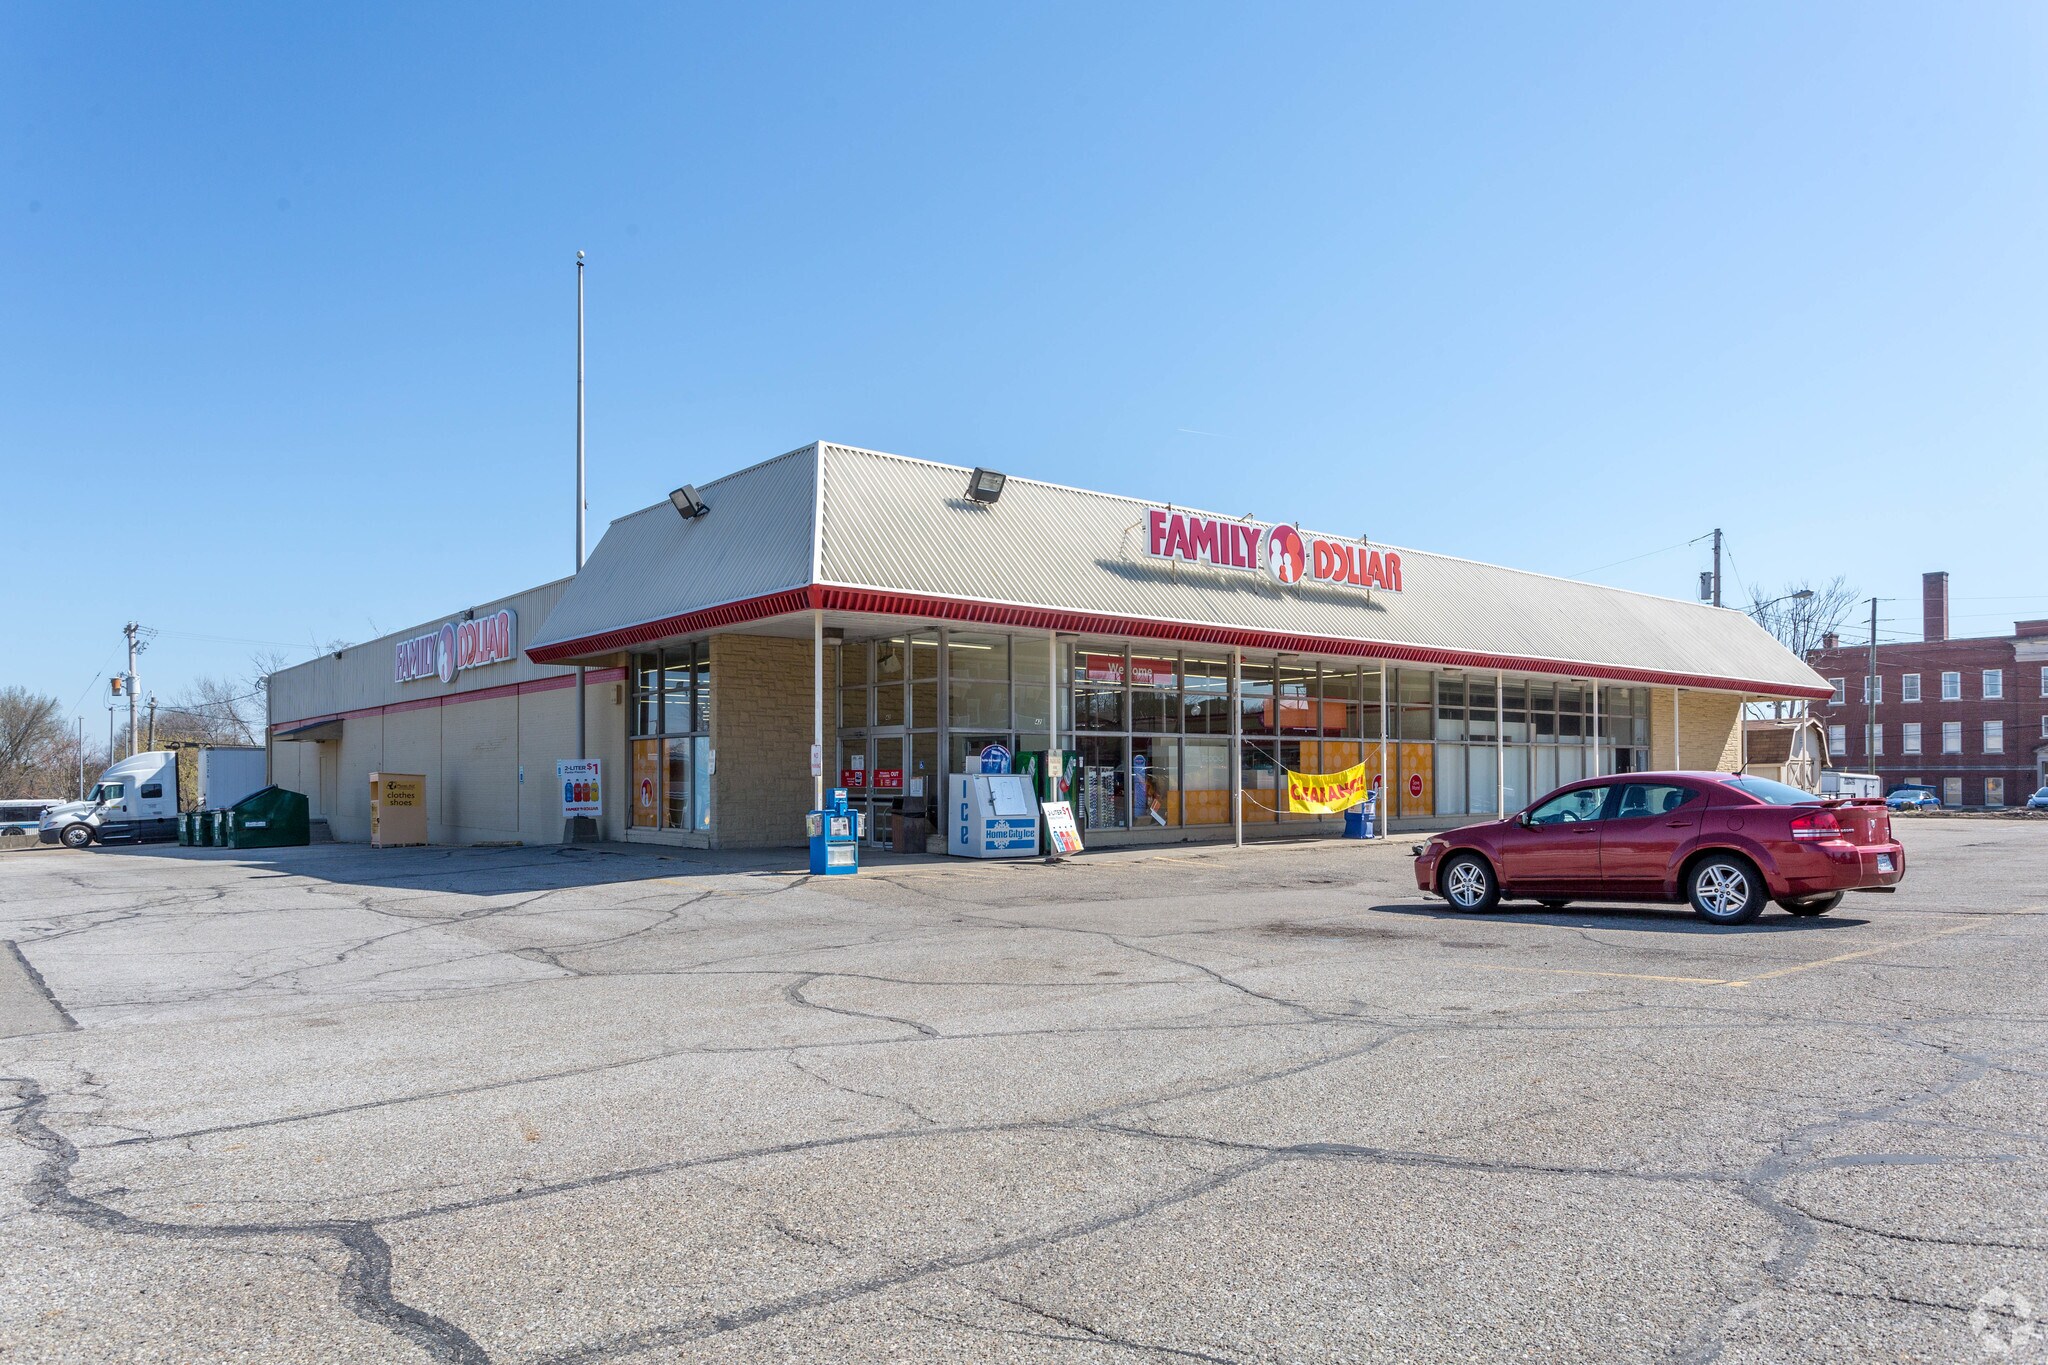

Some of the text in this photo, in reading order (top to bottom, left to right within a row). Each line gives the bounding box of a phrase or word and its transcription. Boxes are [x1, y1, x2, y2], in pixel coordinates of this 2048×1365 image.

[1150, 510, 1402, 592] FAMILY DOLLAR
[396, 612, 509, 681] FAMILY DOLLAR
[387, 791, 415, 799] clothes
[986, 829, 1035, 839] Home City Ice
